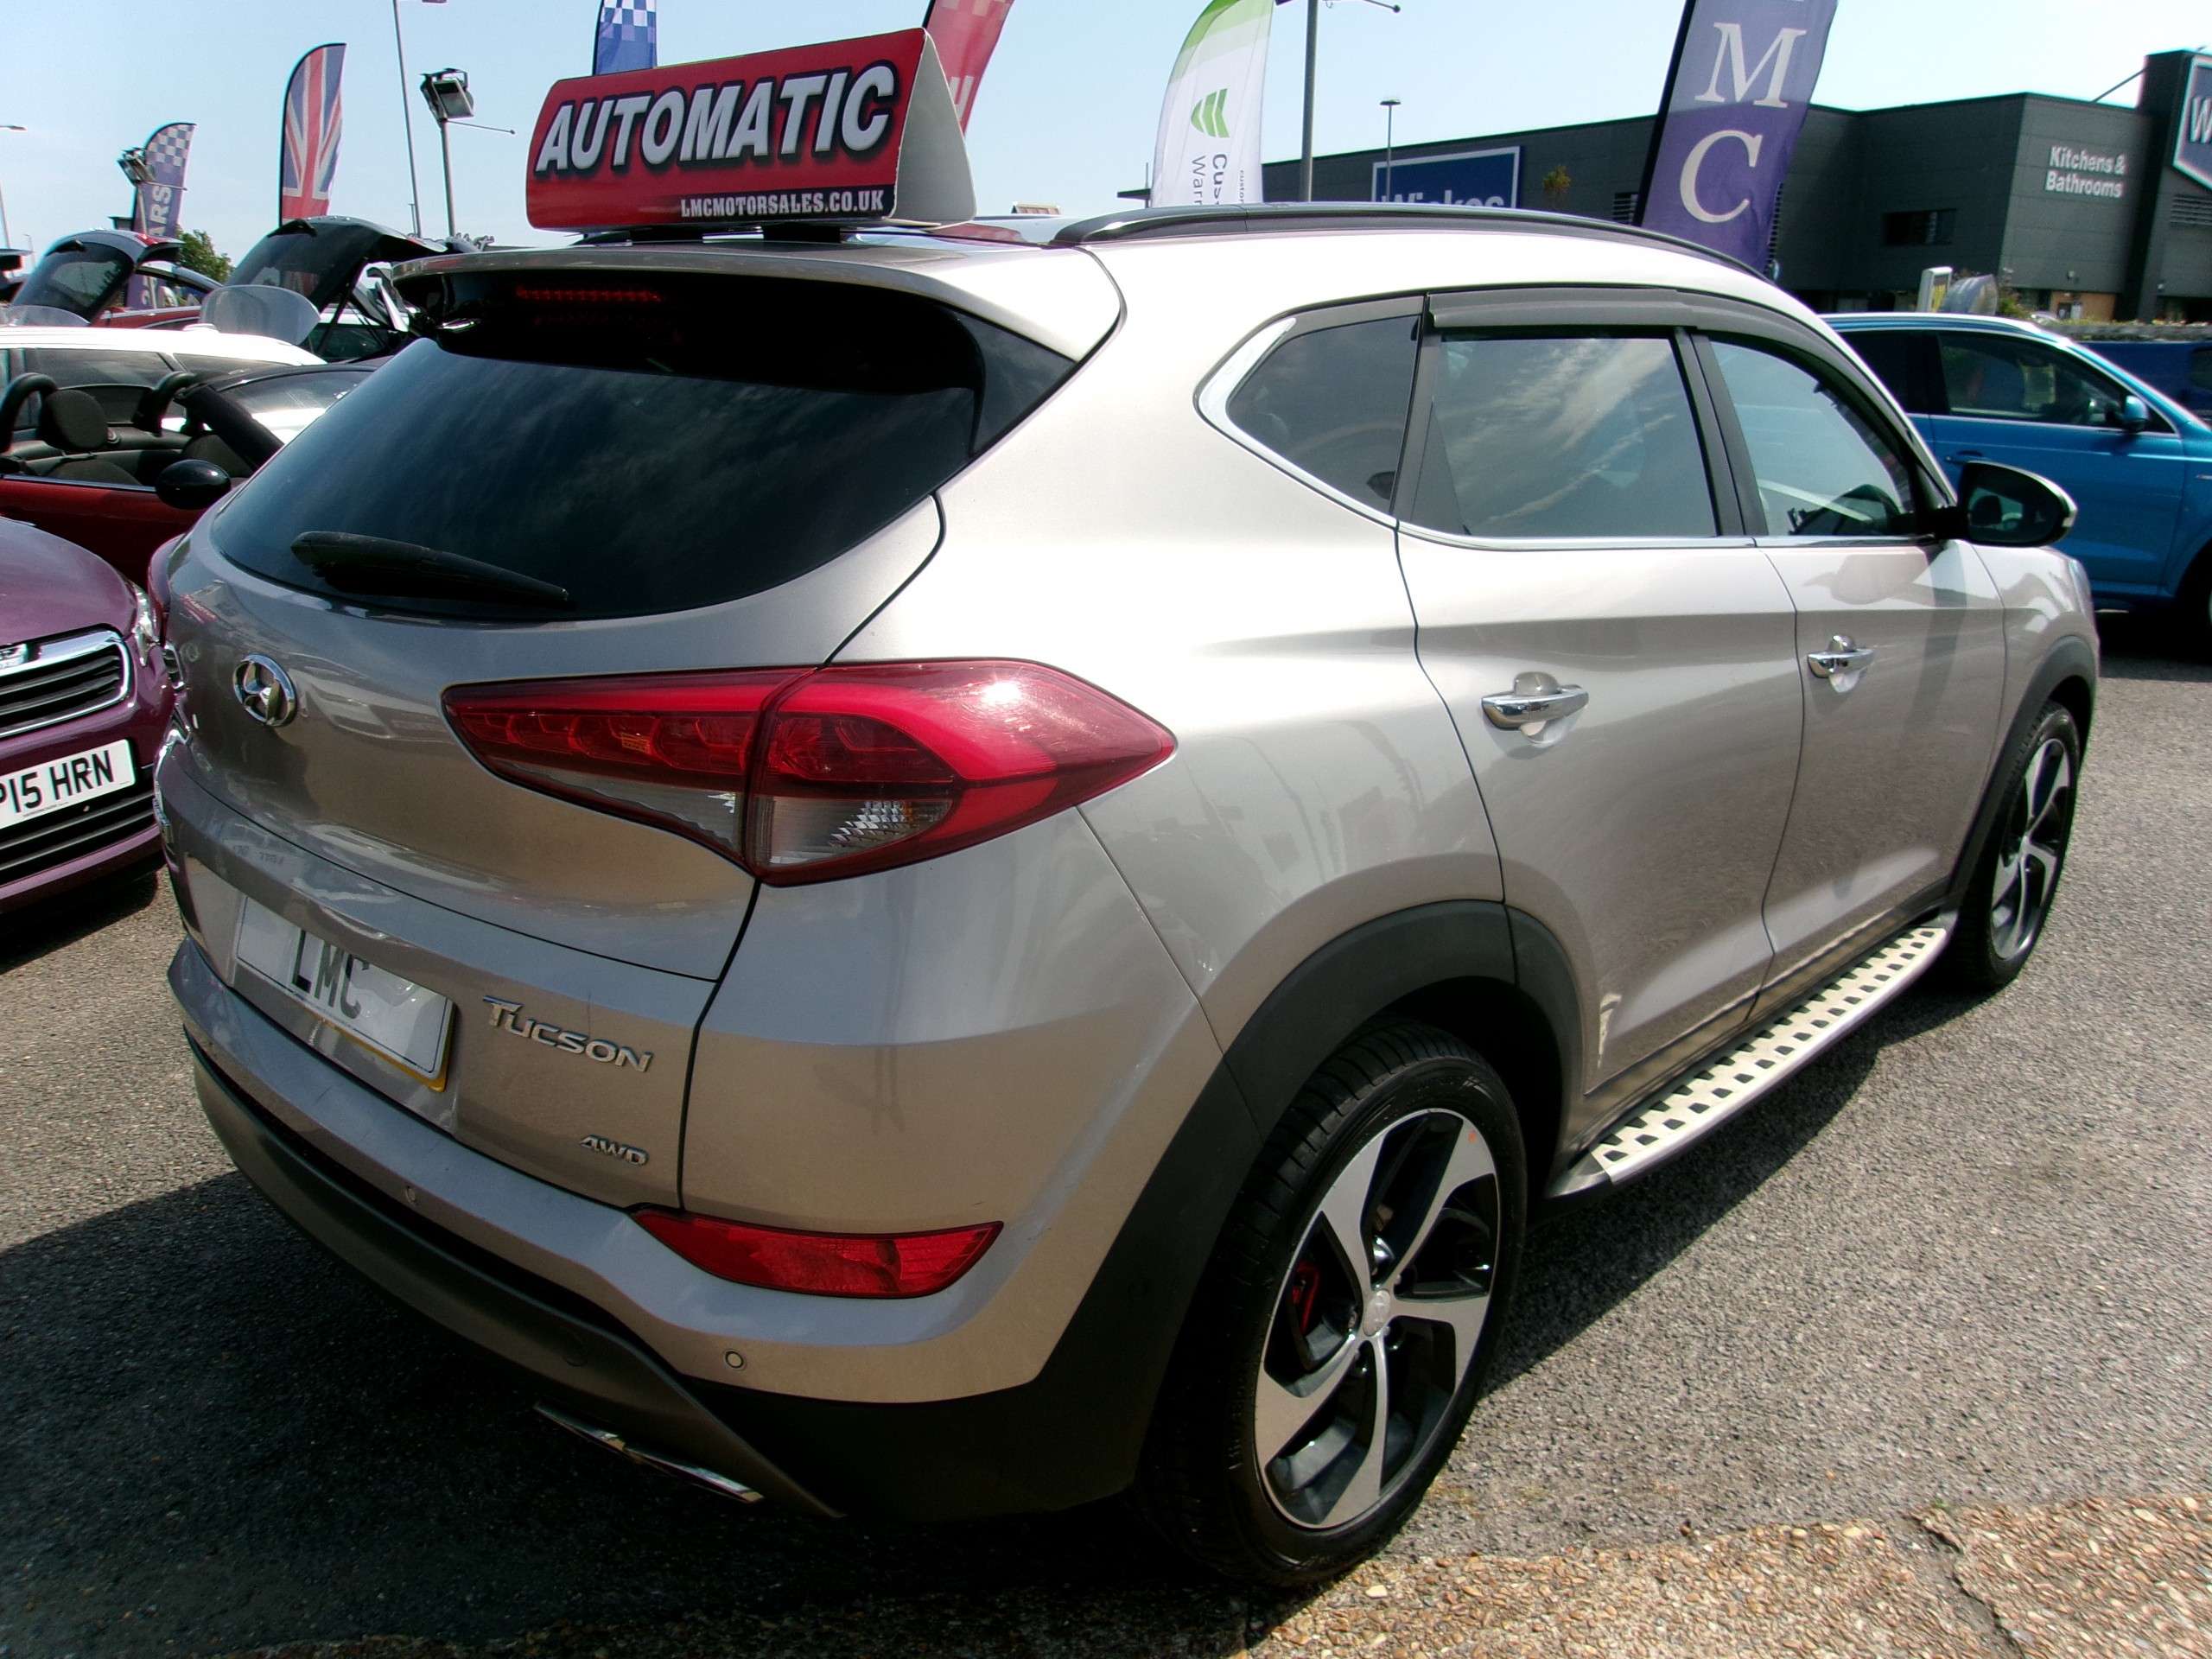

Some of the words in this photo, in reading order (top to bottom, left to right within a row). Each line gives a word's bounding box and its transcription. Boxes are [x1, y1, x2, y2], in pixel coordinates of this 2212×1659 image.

[535, 65, 894, 173] AUTOMATIC
[2049, 146, 2114, 174] Kitchens
[2114, 154, 2126, 175] &
[2044, 170, 2124, 198] Bathrooms
[681, 189, 885, 218] LMCMOTORSALES.CO.UK
[49, 750, 115, 801] HRN
[291, 929, 371, 1020] LMC
[580, 1135, 650, 1166] AWD
